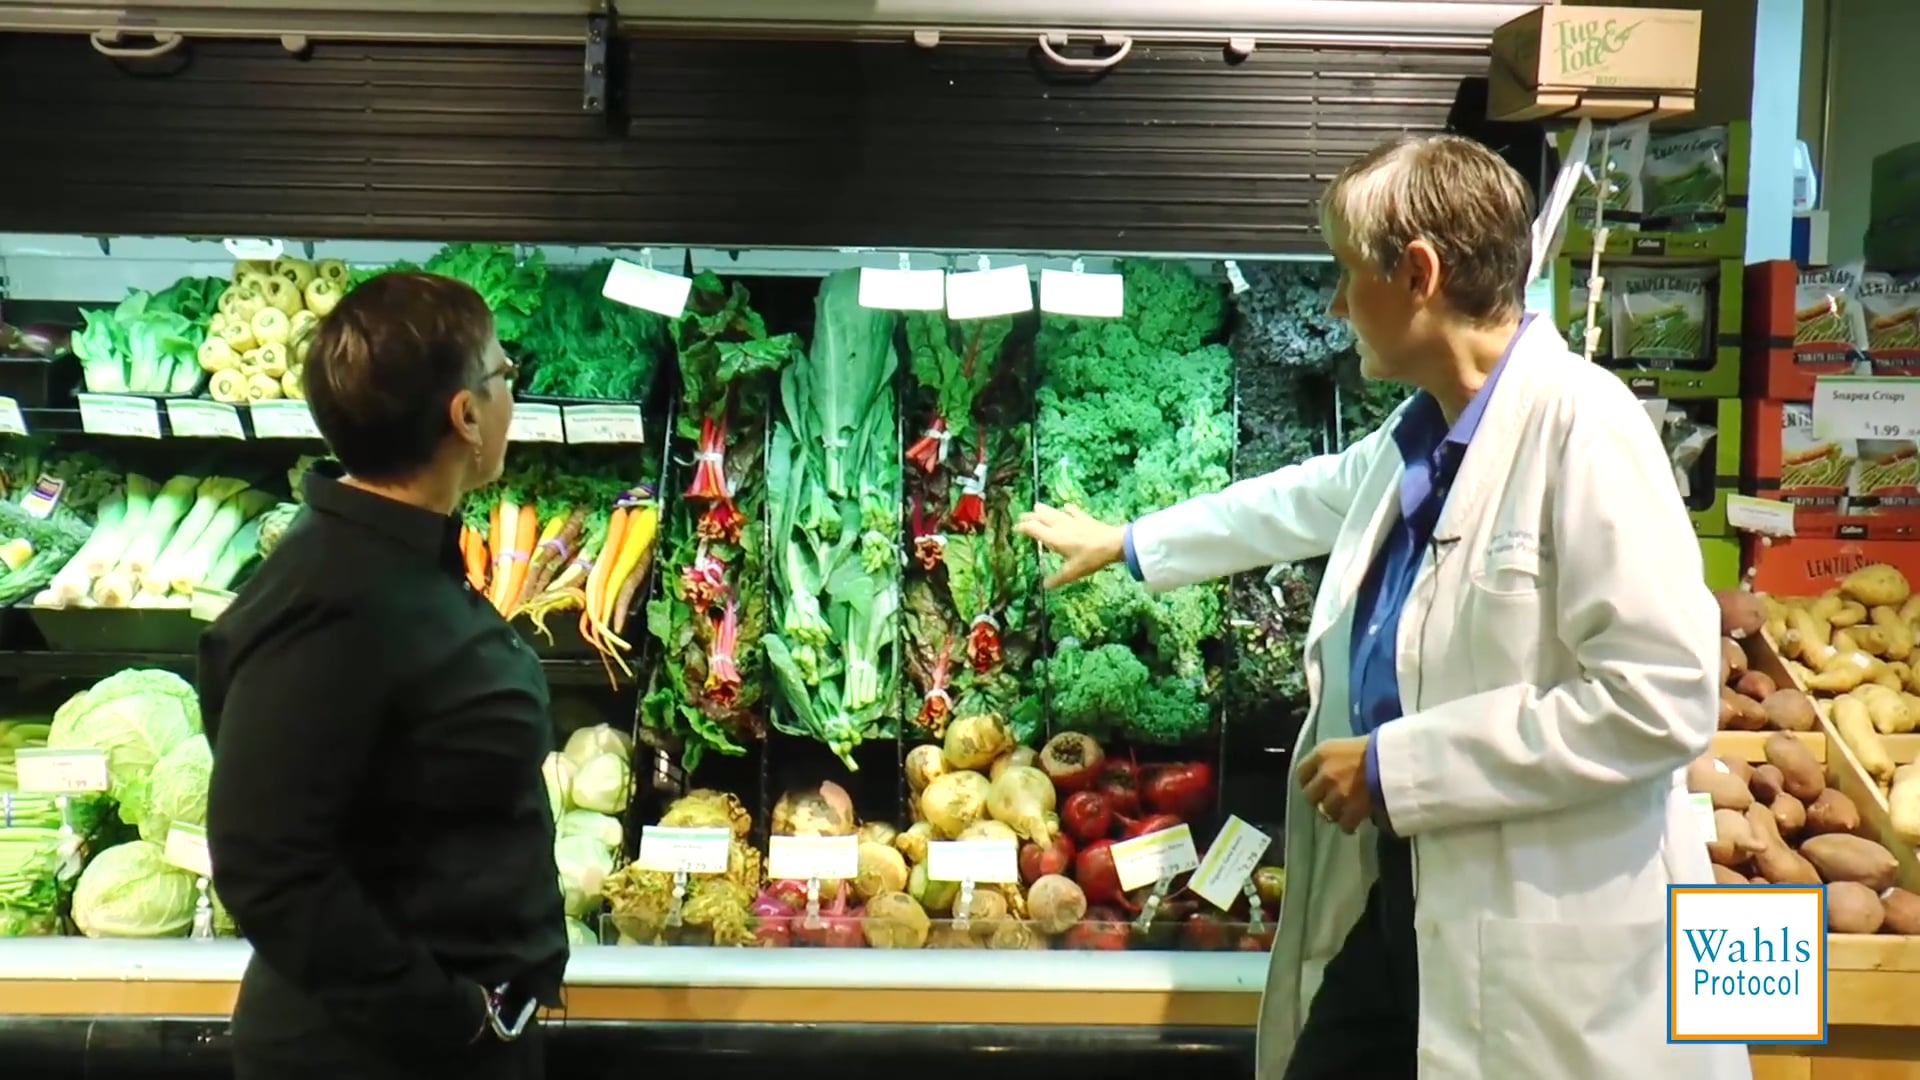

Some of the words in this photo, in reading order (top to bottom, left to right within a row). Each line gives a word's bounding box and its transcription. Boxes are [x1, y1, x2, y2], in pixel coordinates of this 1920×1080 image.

[1552, 20, 1603, 47] Tug
[1601, 19, 1636, 53] &
[1554, 43, 1606, 73] Tote
[1832, 390, 1870, 402] Snapea
[1872, 390, 1905, 403] Crisps
[1806, 556, 1850, 578] LENTIL
